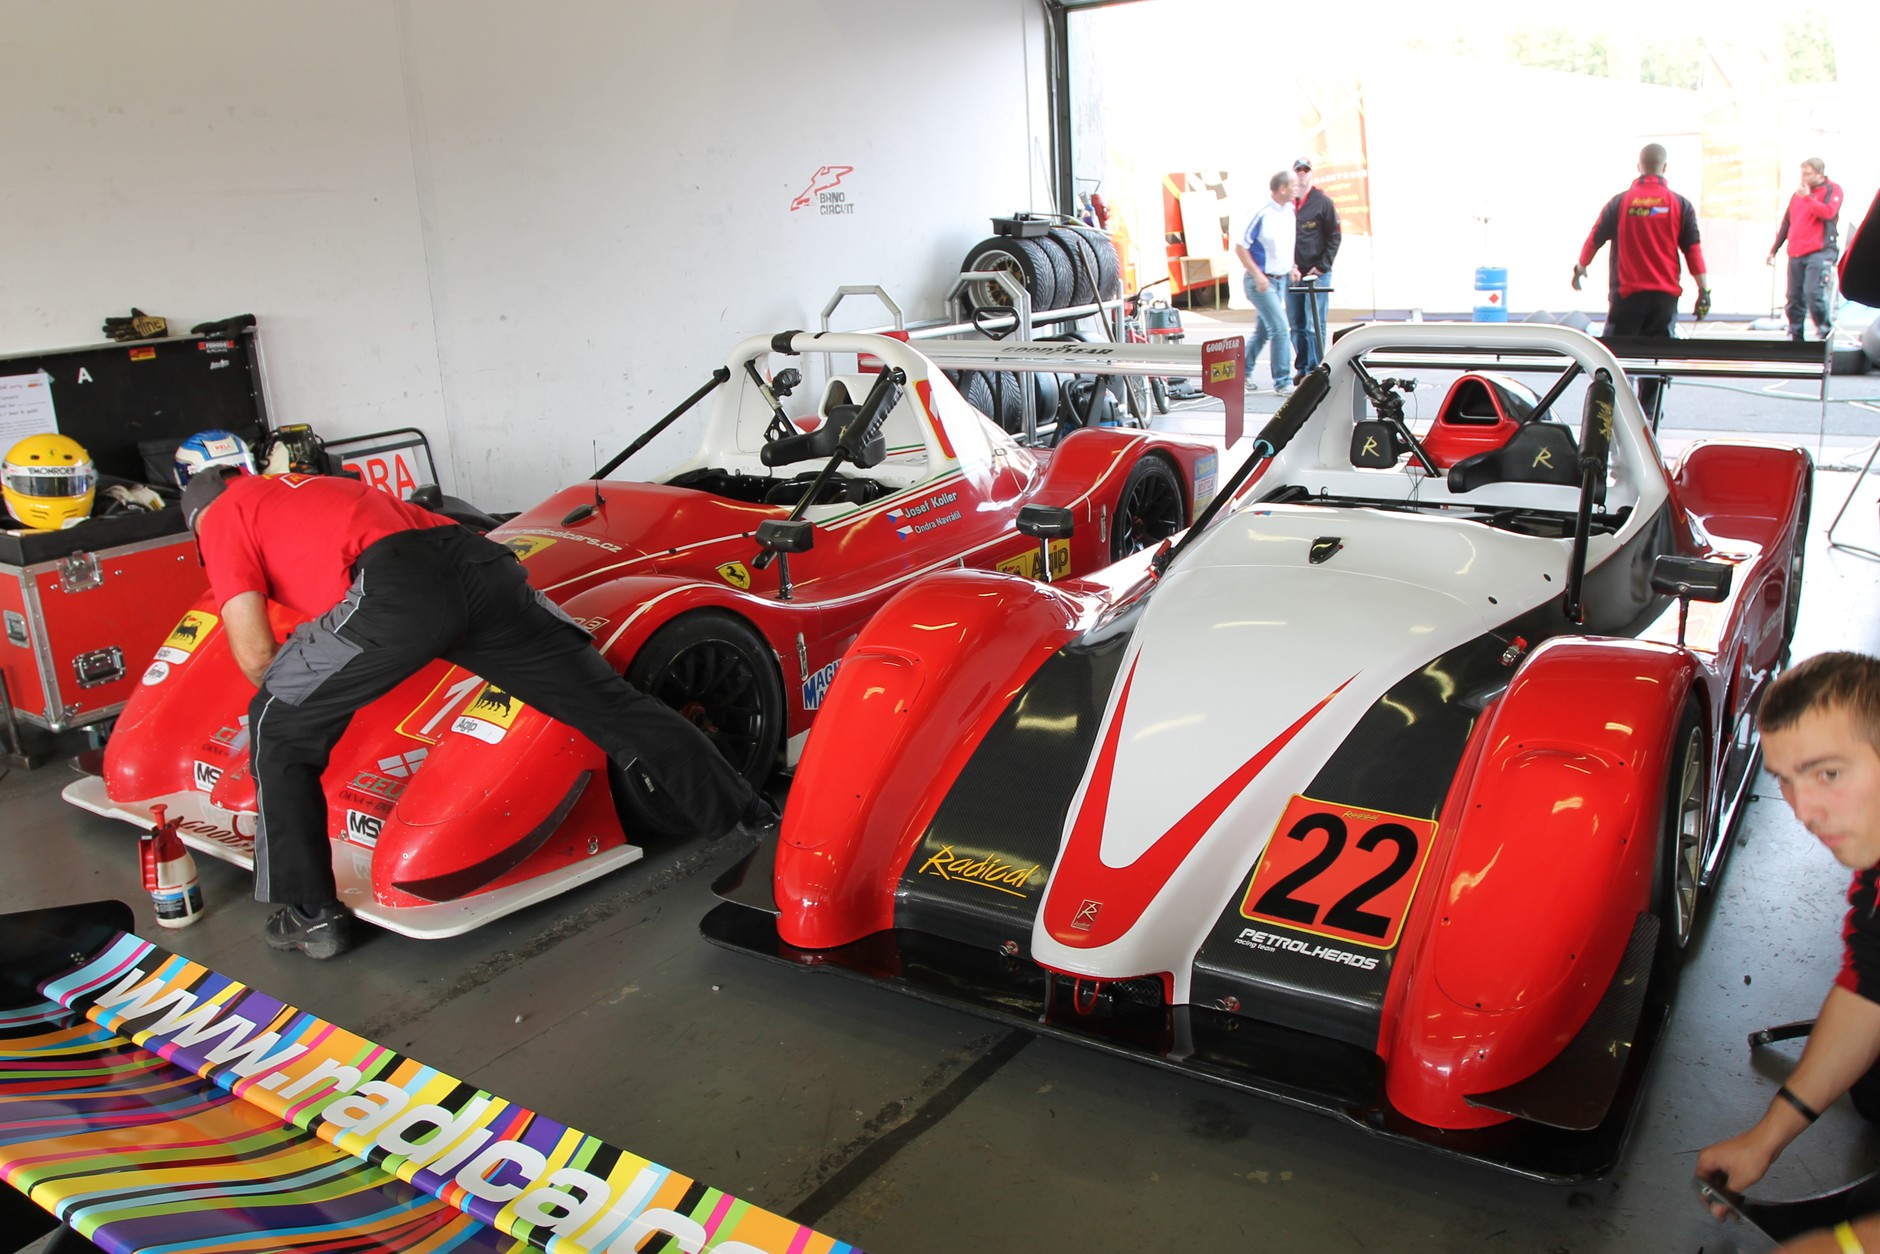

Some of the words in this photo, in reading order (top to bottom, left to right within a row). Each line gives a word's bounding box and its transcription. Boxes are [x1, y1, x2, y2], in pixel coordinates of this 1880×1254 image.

[820, 192, 845, 203] BRNO
[820, 203, 854, 215] CIRCUIT
[1001, 344, 1114, 355] GOODYEAR
[1206, 338, 1240, 353] GOODYEAR
[77, 366, 94, 384] A
[904, 500, 931, 518] Josef
[930, 492, 958, 508] Koller
[914, 522, 937, 534] Ondra
[1031, 545, 1069, 579] Aip
[418, 674, 485, 735] 1
[456, 718, 478, 733] Agip
[918, 844, 1040, 888] Radical
[1252, 812, 1418, 939] 22
[1234, 938, 1257, 949] racing
[1257, 943, 1276, 953] team
[1239, 928, 1380, 970] PETROLHEADS
